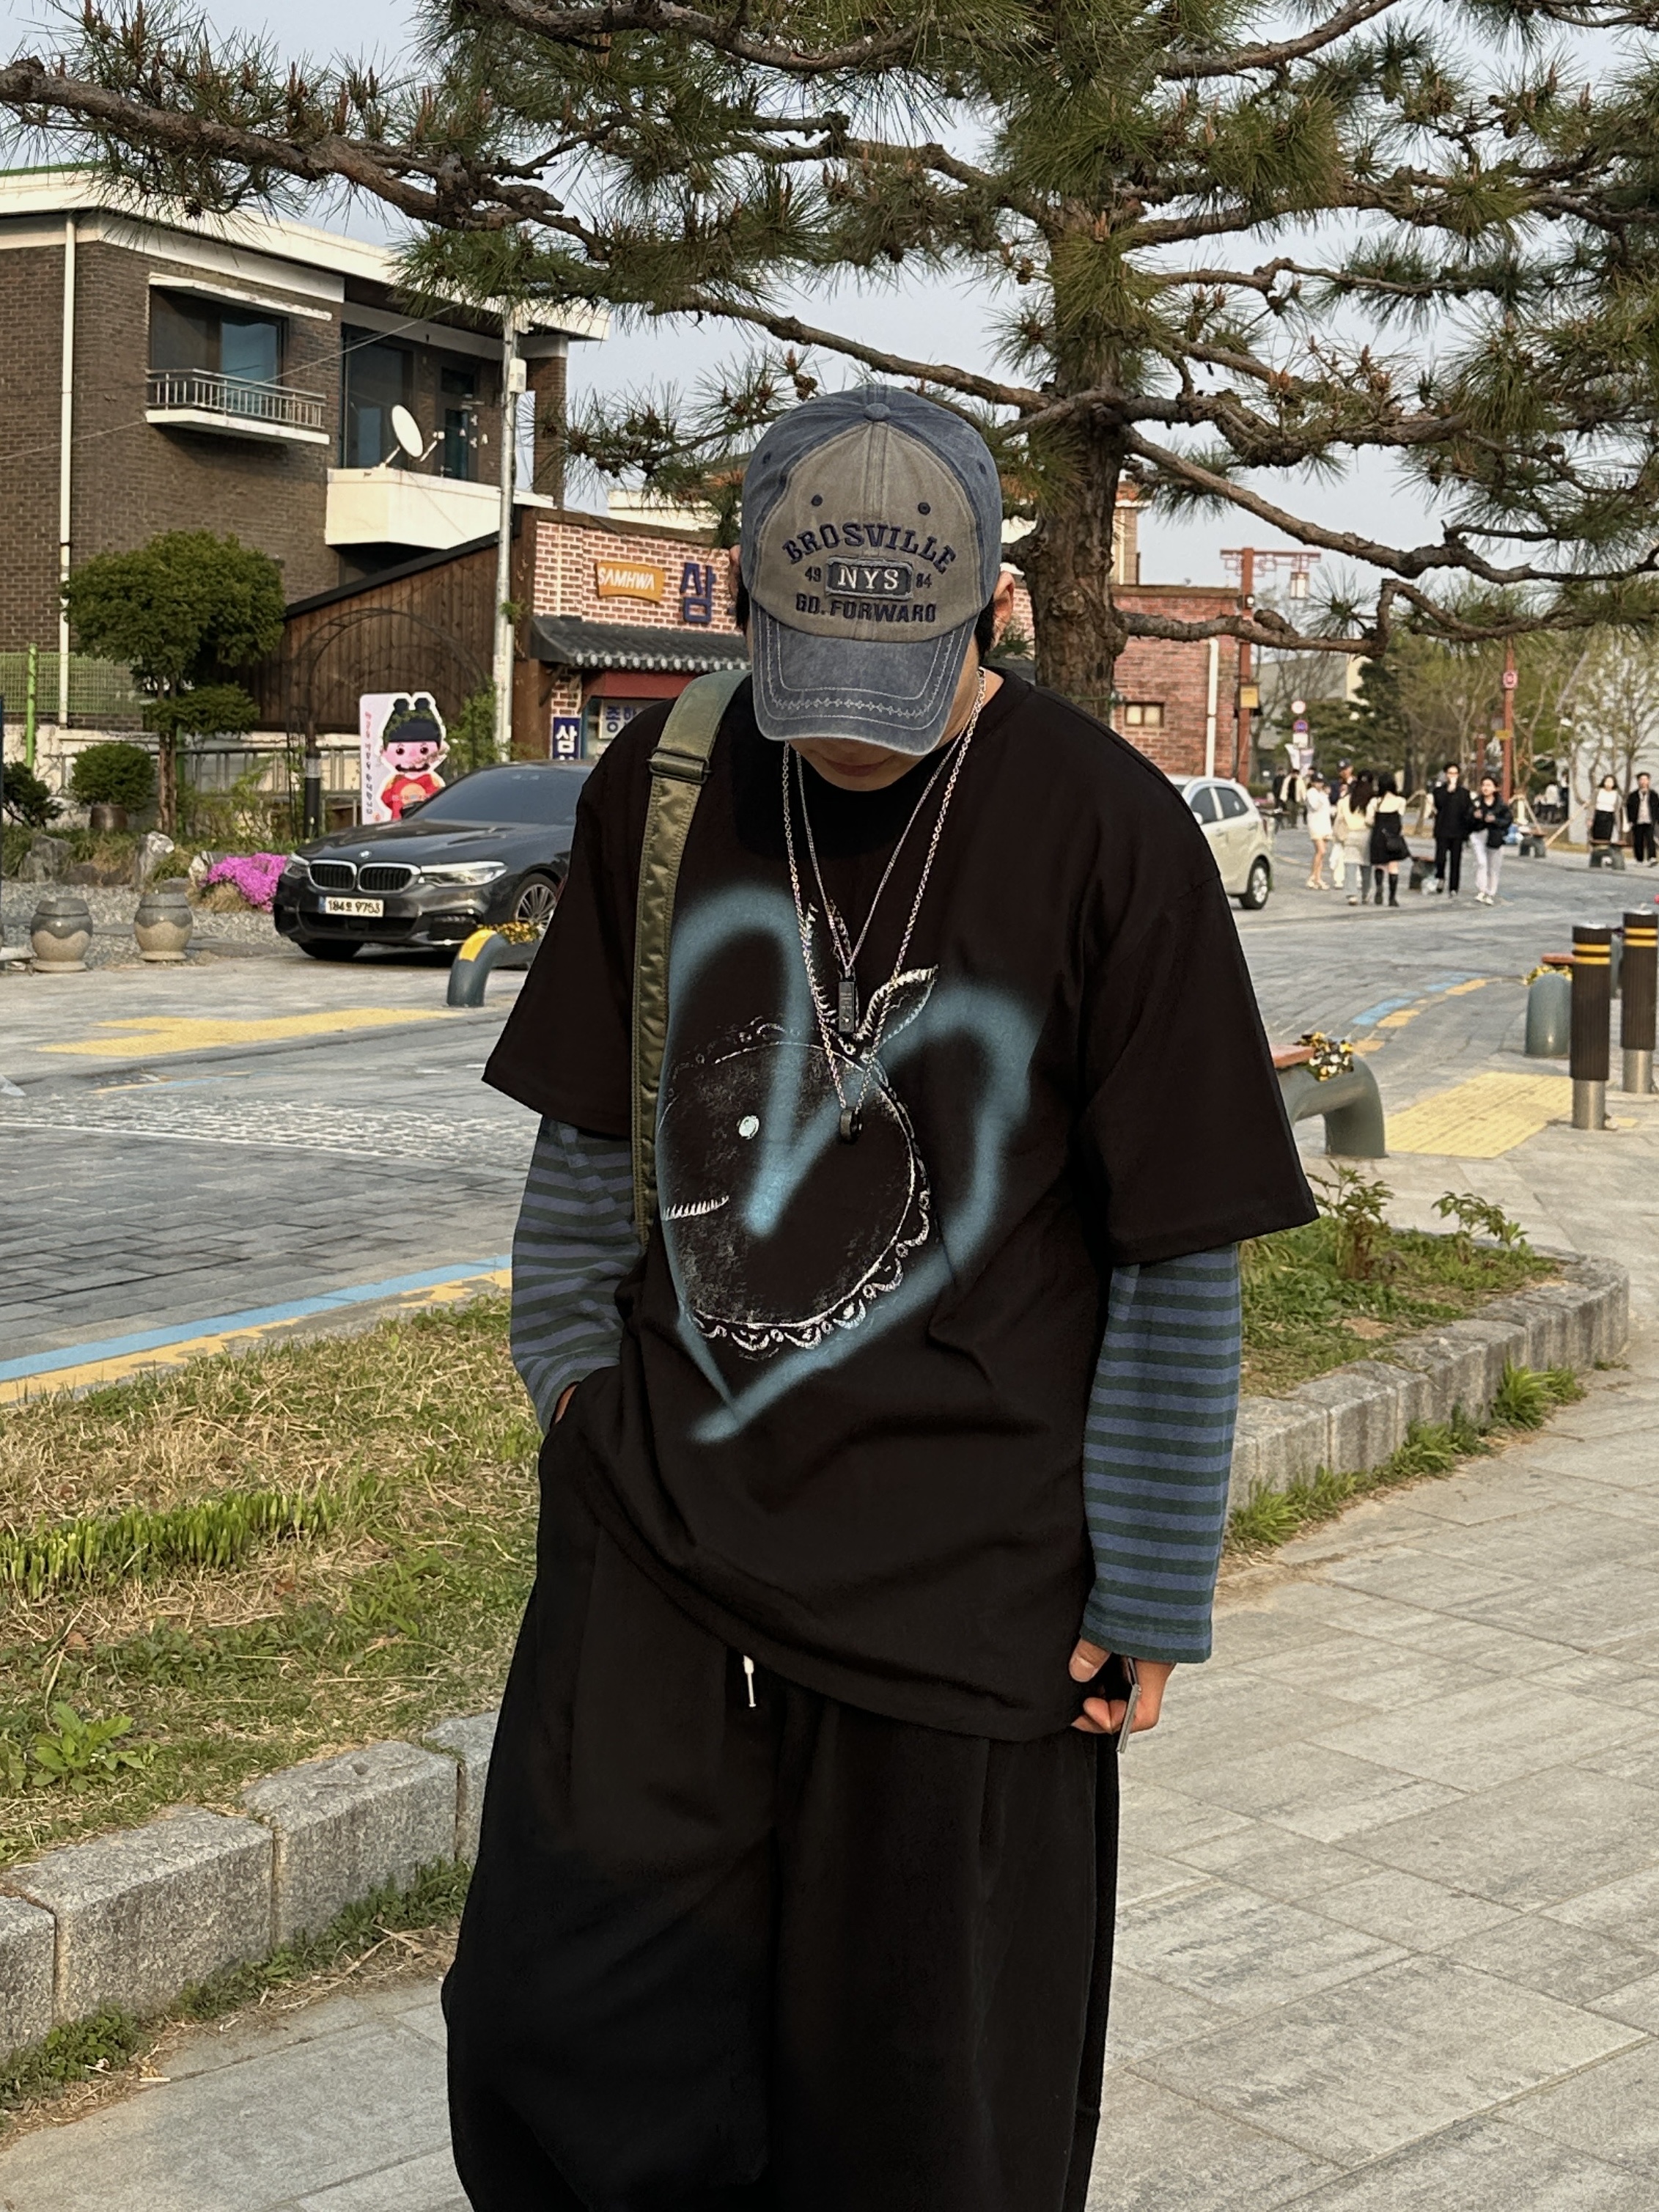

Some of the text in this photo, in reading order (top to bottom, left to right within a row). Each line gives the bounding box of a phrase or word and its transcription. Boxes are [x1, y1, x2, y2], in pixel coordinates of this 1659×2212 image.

[782, 522, 956, 574] BROSVILLE
[598, 567, 655, 591] SAMHWA
[680, 562, 716, 623] 삼
[837, 565, 899, 590] NYS
[830, 600, 937, 623] FORWARD
[555, 724, 578, 760] 삼
